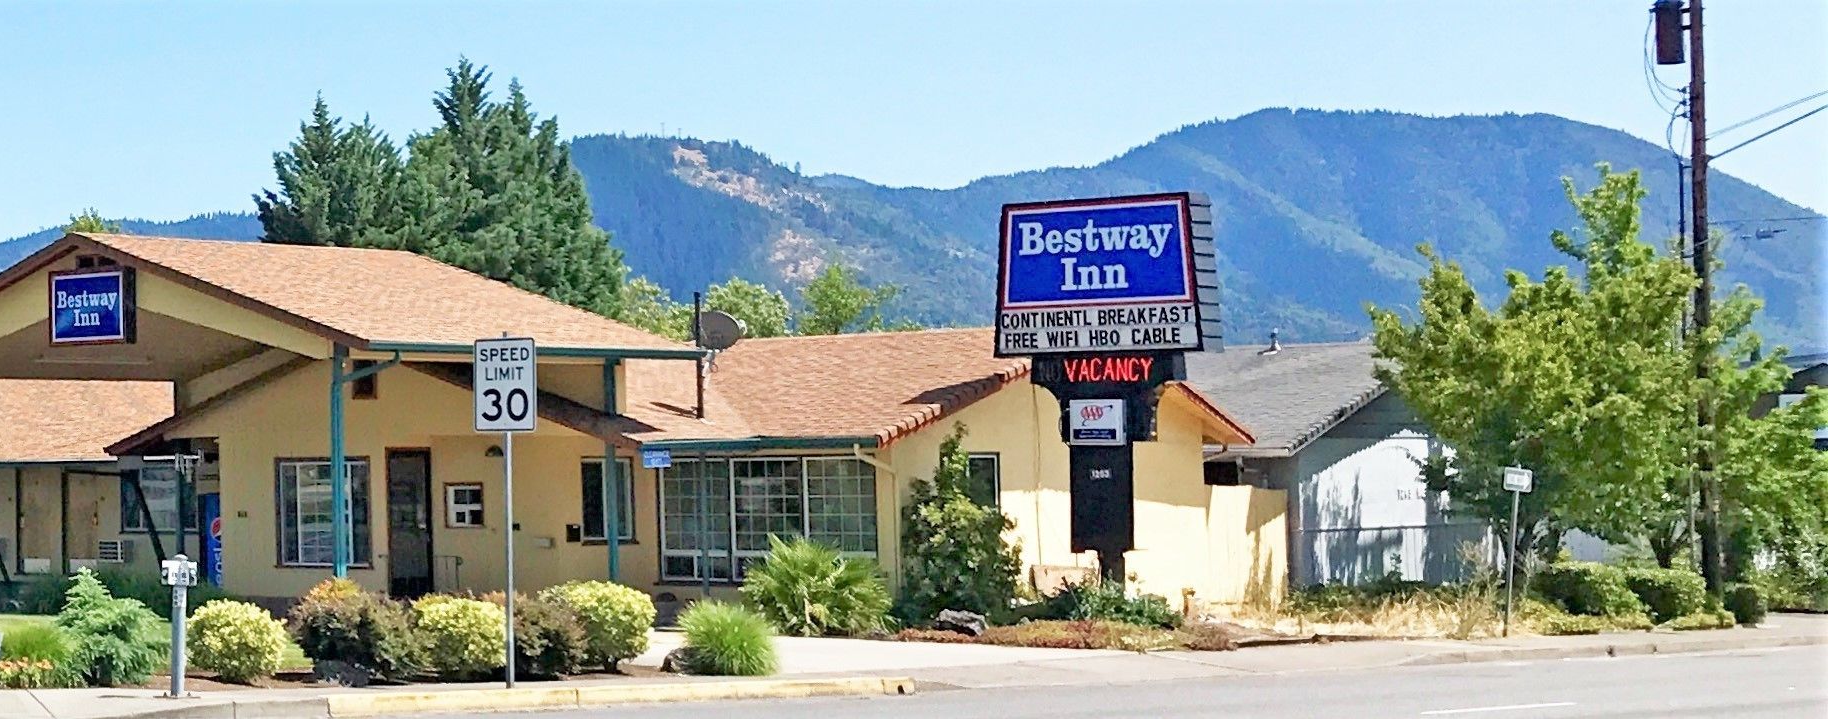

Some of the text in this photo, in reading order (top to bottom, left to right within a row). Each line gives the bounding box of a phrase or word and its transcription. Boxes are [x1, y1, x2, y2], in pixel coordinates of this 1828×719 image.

[1018, 219, 1173, 258] Bestway
[1060, 257, 1129, 291] Inn
[56, 290, 118, 311] Bestway
[73, 309, 101, 327] Inn
[1001, 306, 1192, 330] CONTINENTL BREAKFAST
[1004, 327, 1181, 349] FREE WIFI HBO CABLE
[479, 347, 530, 362] SPEED
[484, 366, 525, 381] LIMIT
[1063, 357, 1154, 383] VACANCY
[481, 388, 529, 422] 30
